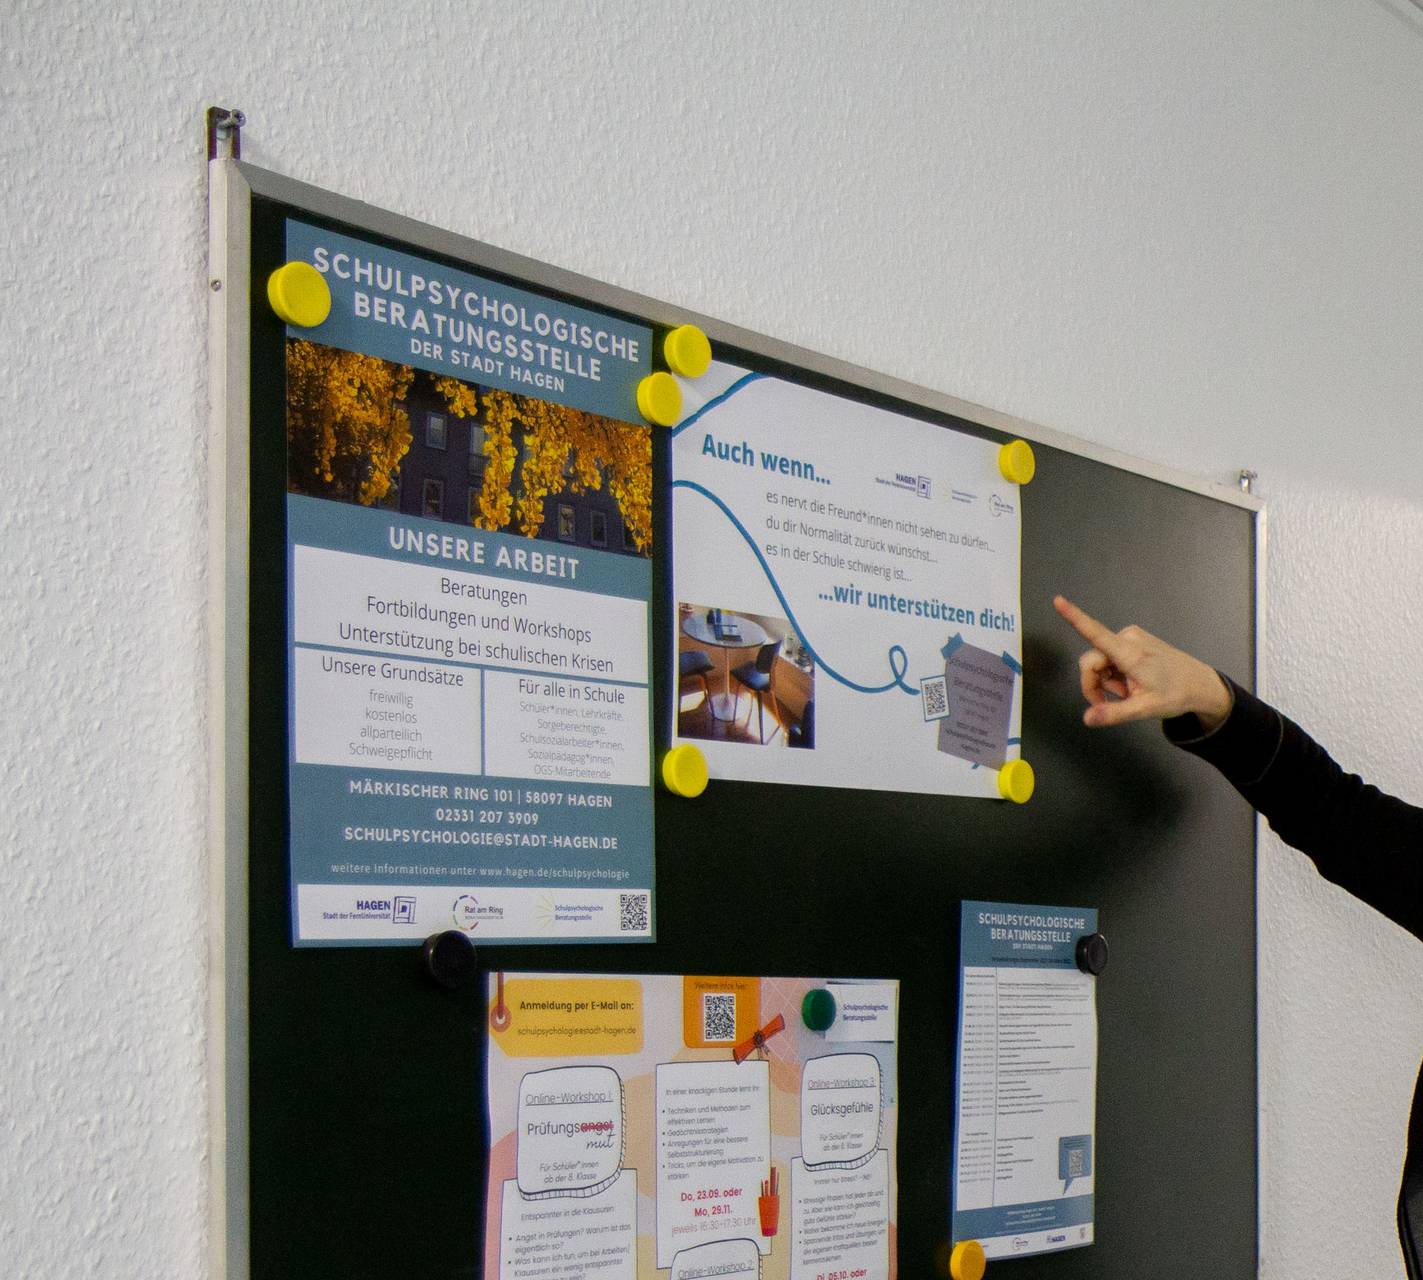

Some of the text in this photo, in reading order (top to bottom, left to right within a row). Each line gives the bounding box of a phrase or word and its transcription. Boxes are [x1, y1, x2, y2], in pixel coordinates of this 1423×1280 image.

[312, 247, 641, 363] SCHULPSYCHOLOGISCHE
[353, 290, 602, 382] BERATUNGSSTELLE
[410, 337, 566, 393] DER STADT HAGEN
[702, 433, 831, 485] Auch wenn...
[766, 491, 778, 504] es
[781, 494, 808, 511] nervt
[810, 499, 826, 515] die
[895, 519, 919, 536] nicht
[919, 524, 947, 542] sehen
[949, 532, 960, 545] zu
[766, 515, 780, 530] du
[783, 518, 797, 533] dir
[799, 521, 852, 546] Normalität
[854, 534, 886, 553] zurück
[388, 526, 581, 580] UNSERE ARBEIT
[766, 543, 778, 556] es
[780, 543, 791, 558] in
[793, 546, 811, 563] der
[812, 550, 846, 569] Schule
[847, 558, 892, 582] schwierig
[440, 576, 528, 608] Beratungen
[818, 583, 1015, 633] ...wir unterstützen dich!
[366, 594, 593, 646] Fortbildungen und Workshops
[338, 621, 615, 674] Unterstützung bei schulischen Krisen
[321, 655, 465, 688] Unsere Grundsätze
[368, 688, 415, 710] freiwillig
[518, 678, 626, 705] Für alle in Schule
[365, 706, 419, 724] kostenlos
[359, 725, 424, 743] allparteilich
[348, 741, 434, 762] Schweigepflicht
[349, 777, 449, 800] MÄRKISCHER
[454, 786, 490, 801] RING
[493, 788, 514, 802] 101
[525, 791, 564, 806] 58097
[567, 793, 613, 809] HAGEN
[435, 807, 540, 825] 02331 207 3909
[343, 826, 619, 850] SCHULPSYCHOLOGIE@STADT-HAGEN.DE
[330, 862, 631, 881] weitere Informationen unter www.hagen.de/schulpsychologie
[322, 911, 338, 920] Stadt
[356, 899, 392, 911] HAGEN
[464, 905, 476, 914] Rat
[488, 906, 504, 916] Ring
[978, 912, 1086, 930] SCHULPSYCHOLOGISCHE
[991, 928, 1072, 943] BERATUNGSSTELLE
[519, 1000, 635, 1013] Anmeldung per E-Mail an:
[525, 1091, 606, 1106] Online-Workshop
[810, 1101, 874, 1118] Glücksgefühle
[586, 1133, 616, 1149] mut
[680, 1187, 744, 1202] Do, 23.09. oder
[694, 1204, 733, 1218] Mo, 29.11.
